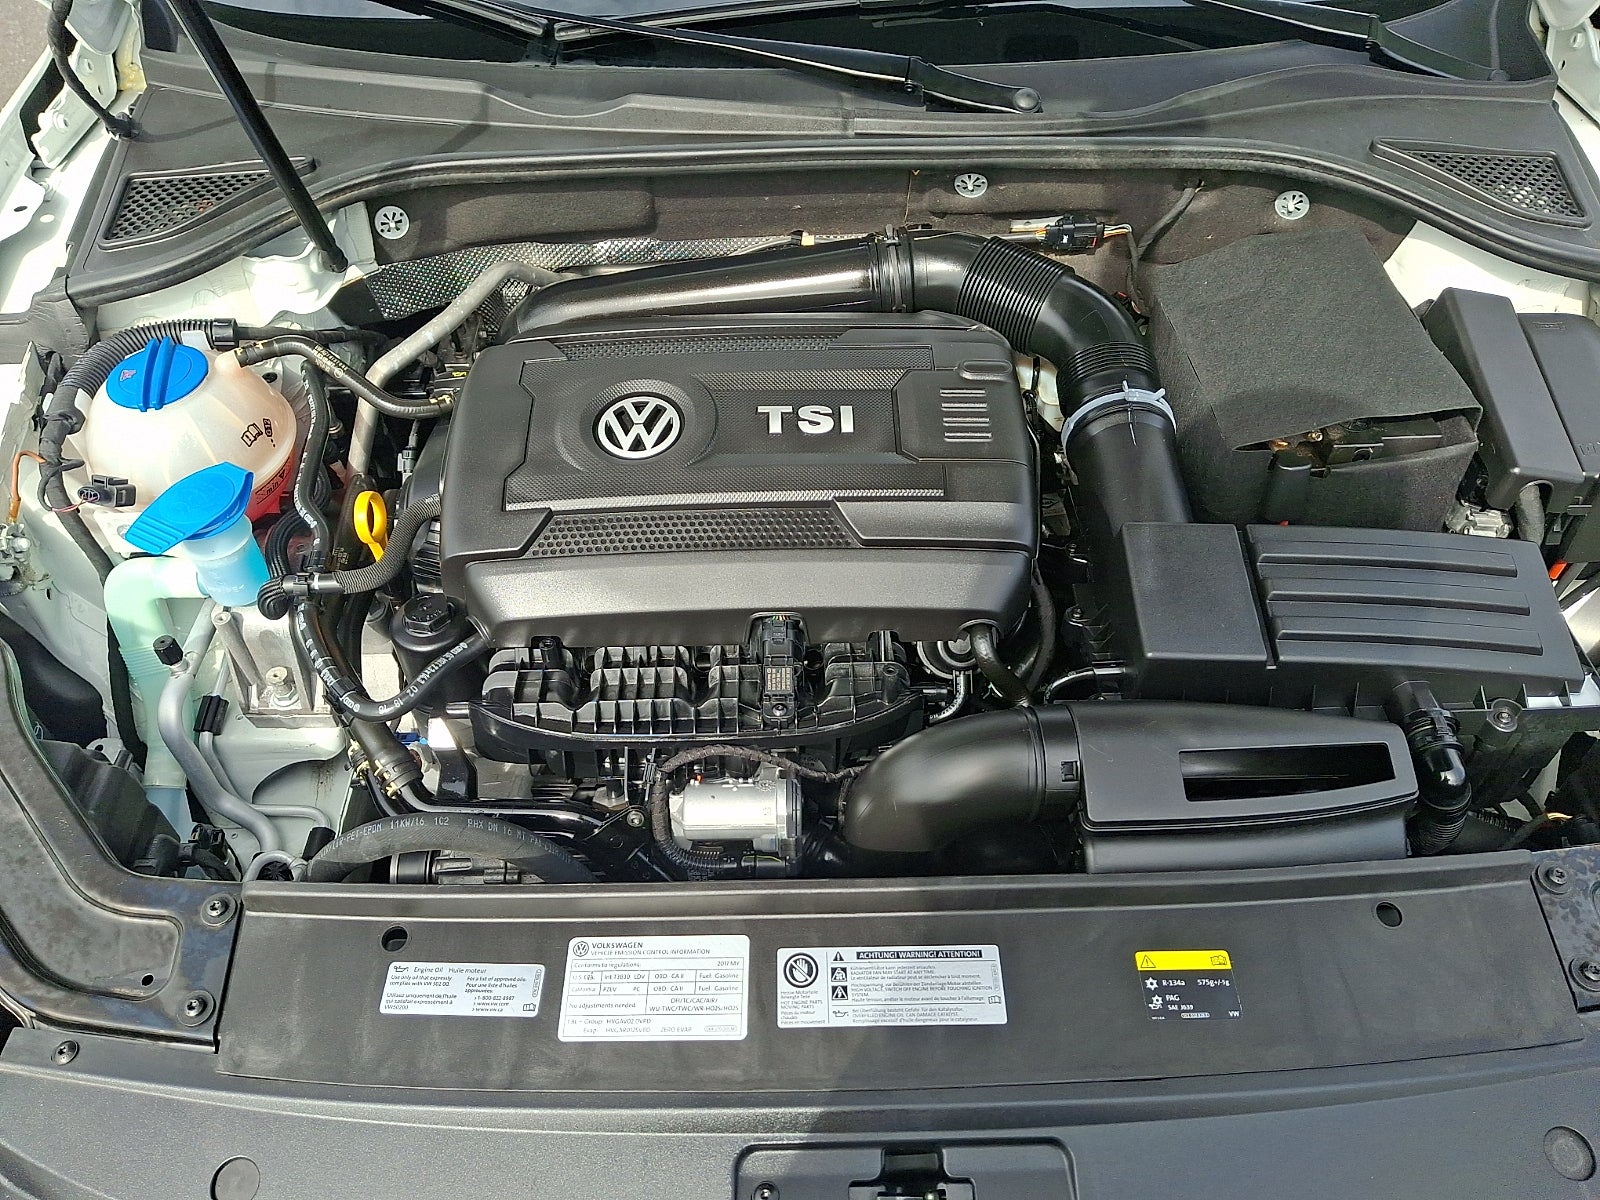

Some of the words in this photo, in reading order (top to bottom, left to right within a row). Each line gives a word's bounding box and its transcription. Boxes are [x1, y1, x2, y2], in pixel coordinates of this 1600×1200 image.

[757, 405, 854, 434] TSI
[266, 481, 279, 495] min
[467, 818, 484, 829] PHX
